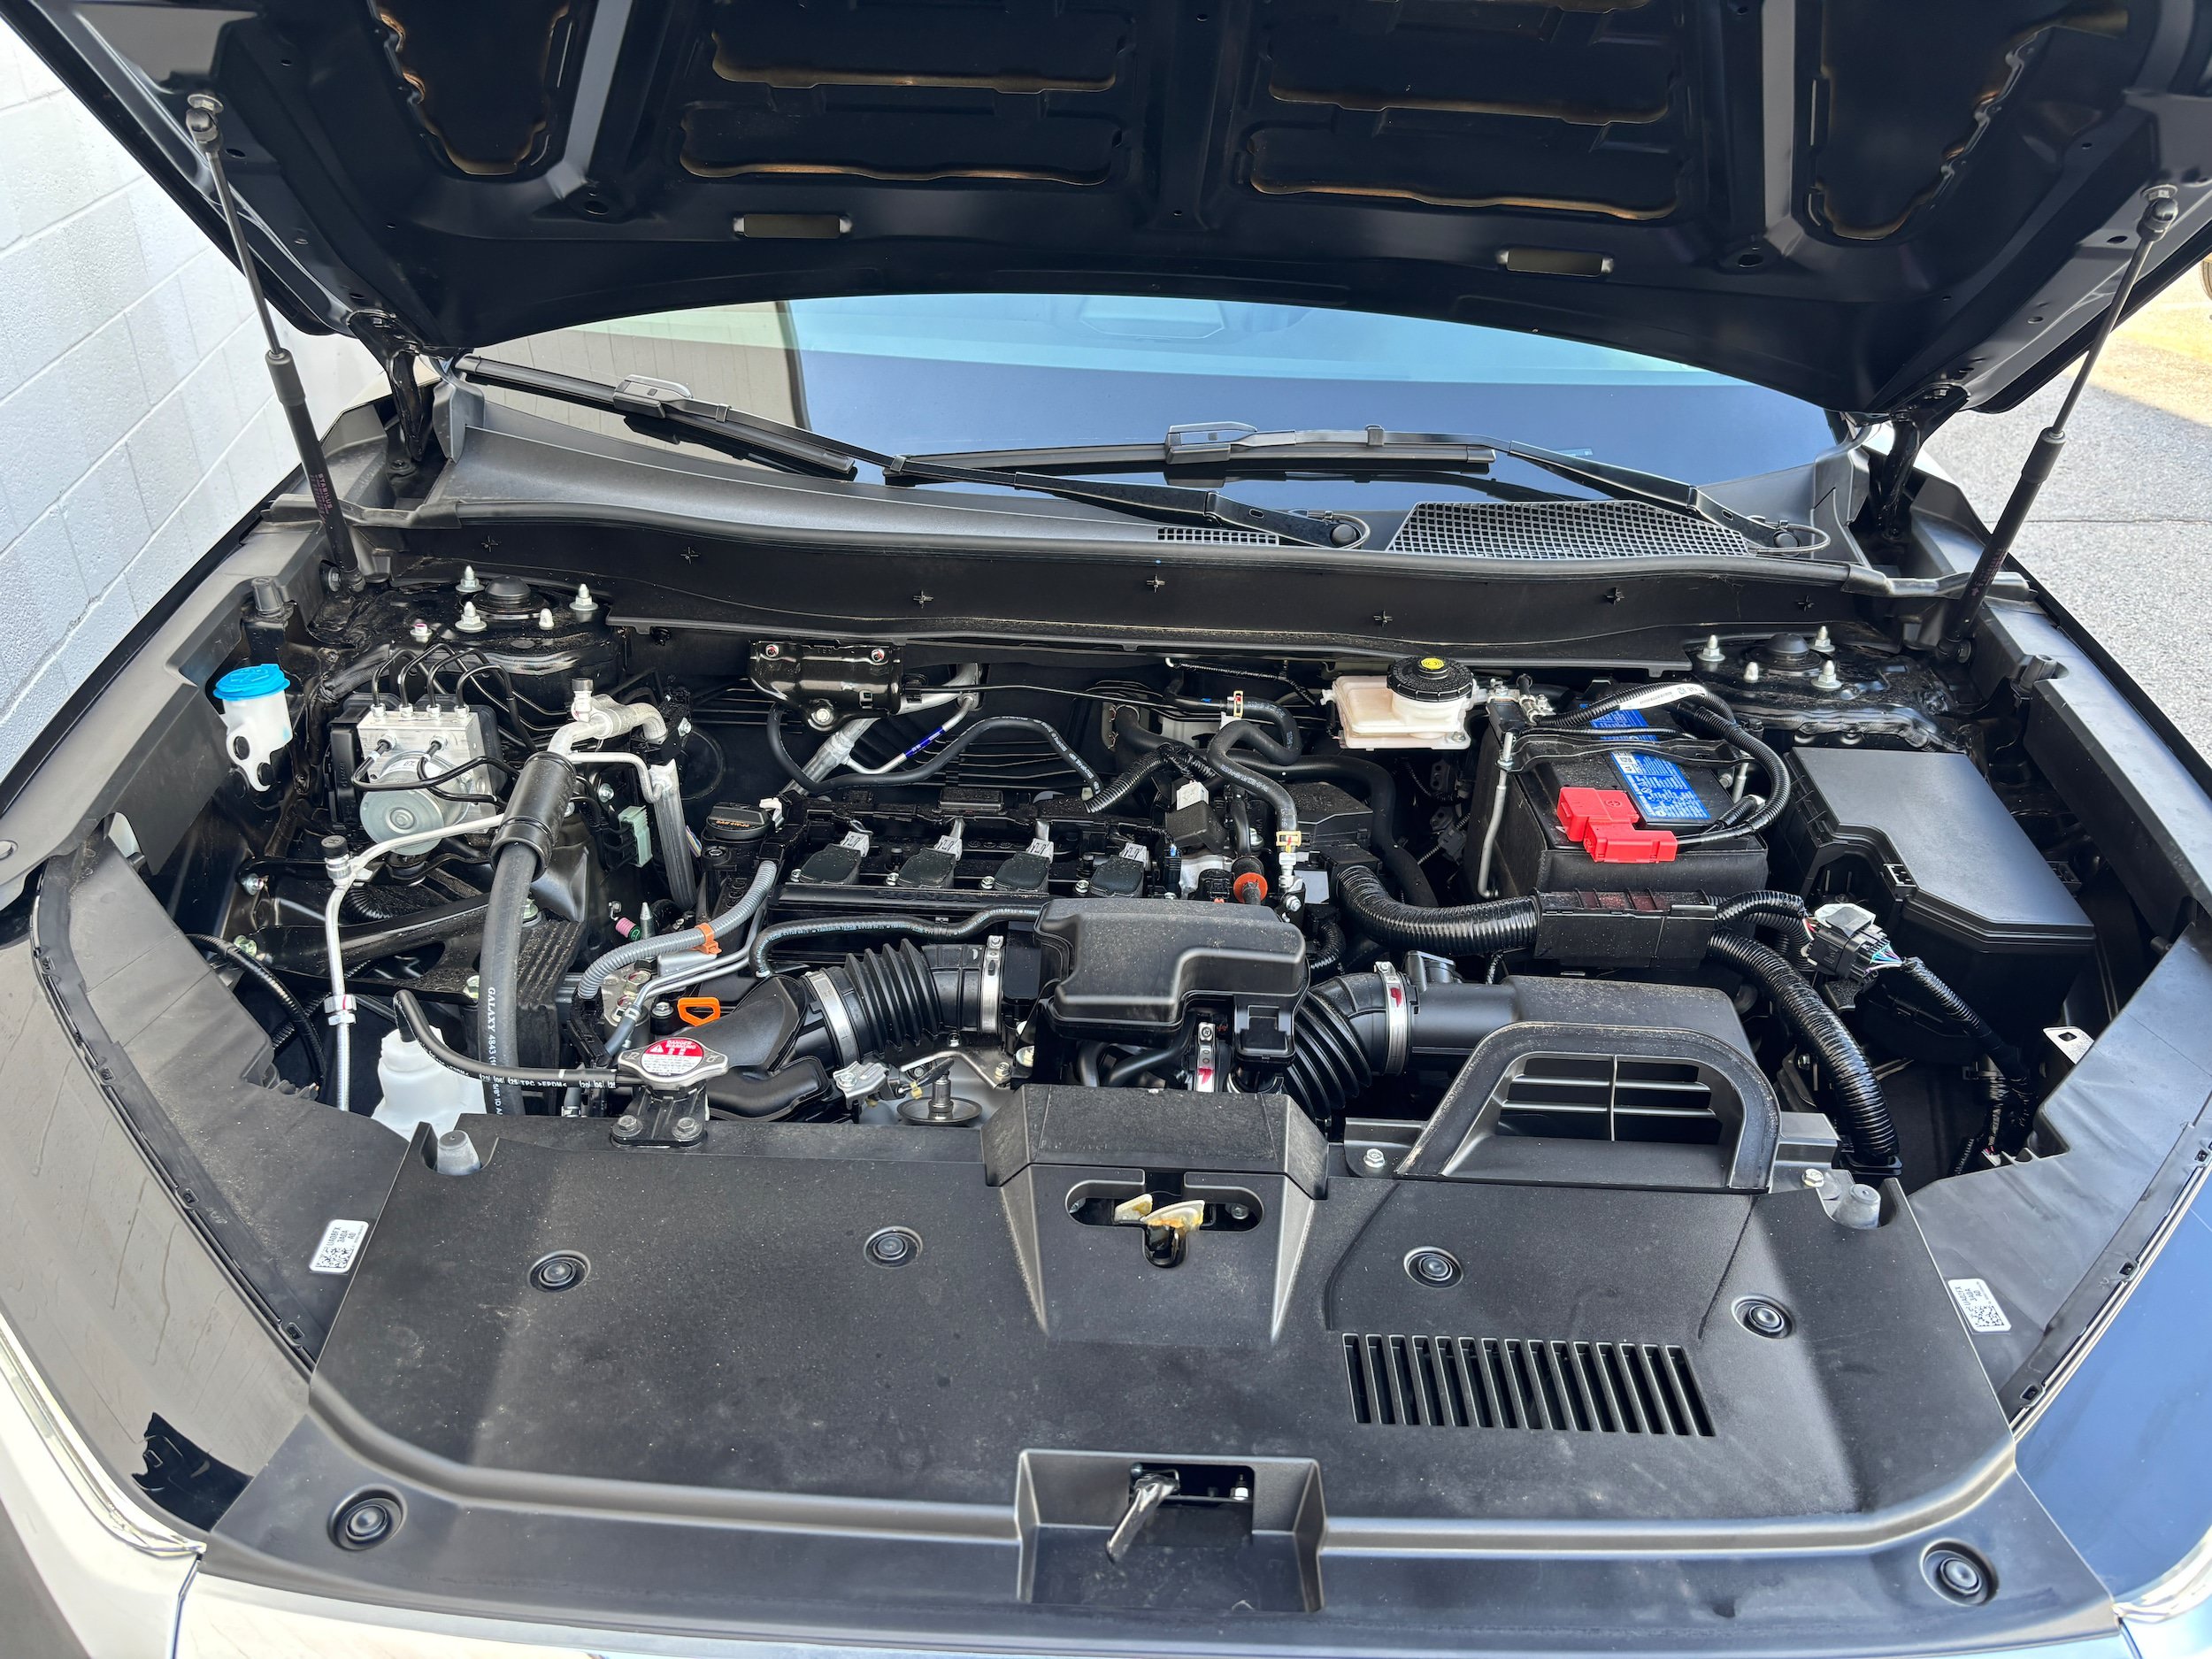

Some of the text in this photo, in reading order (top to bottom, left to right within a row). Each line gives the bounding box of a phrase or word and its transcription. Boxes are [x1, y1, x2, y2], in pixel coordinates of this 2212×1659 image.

[319, 473, 333, 509] STABILUS
[873, 890, 981, 903] HONDA
[488, 987, 496, 1033] GALAXY
[488, 1033, 497, 1055] 4843
[520, 1079, 536, 1087] TPC
